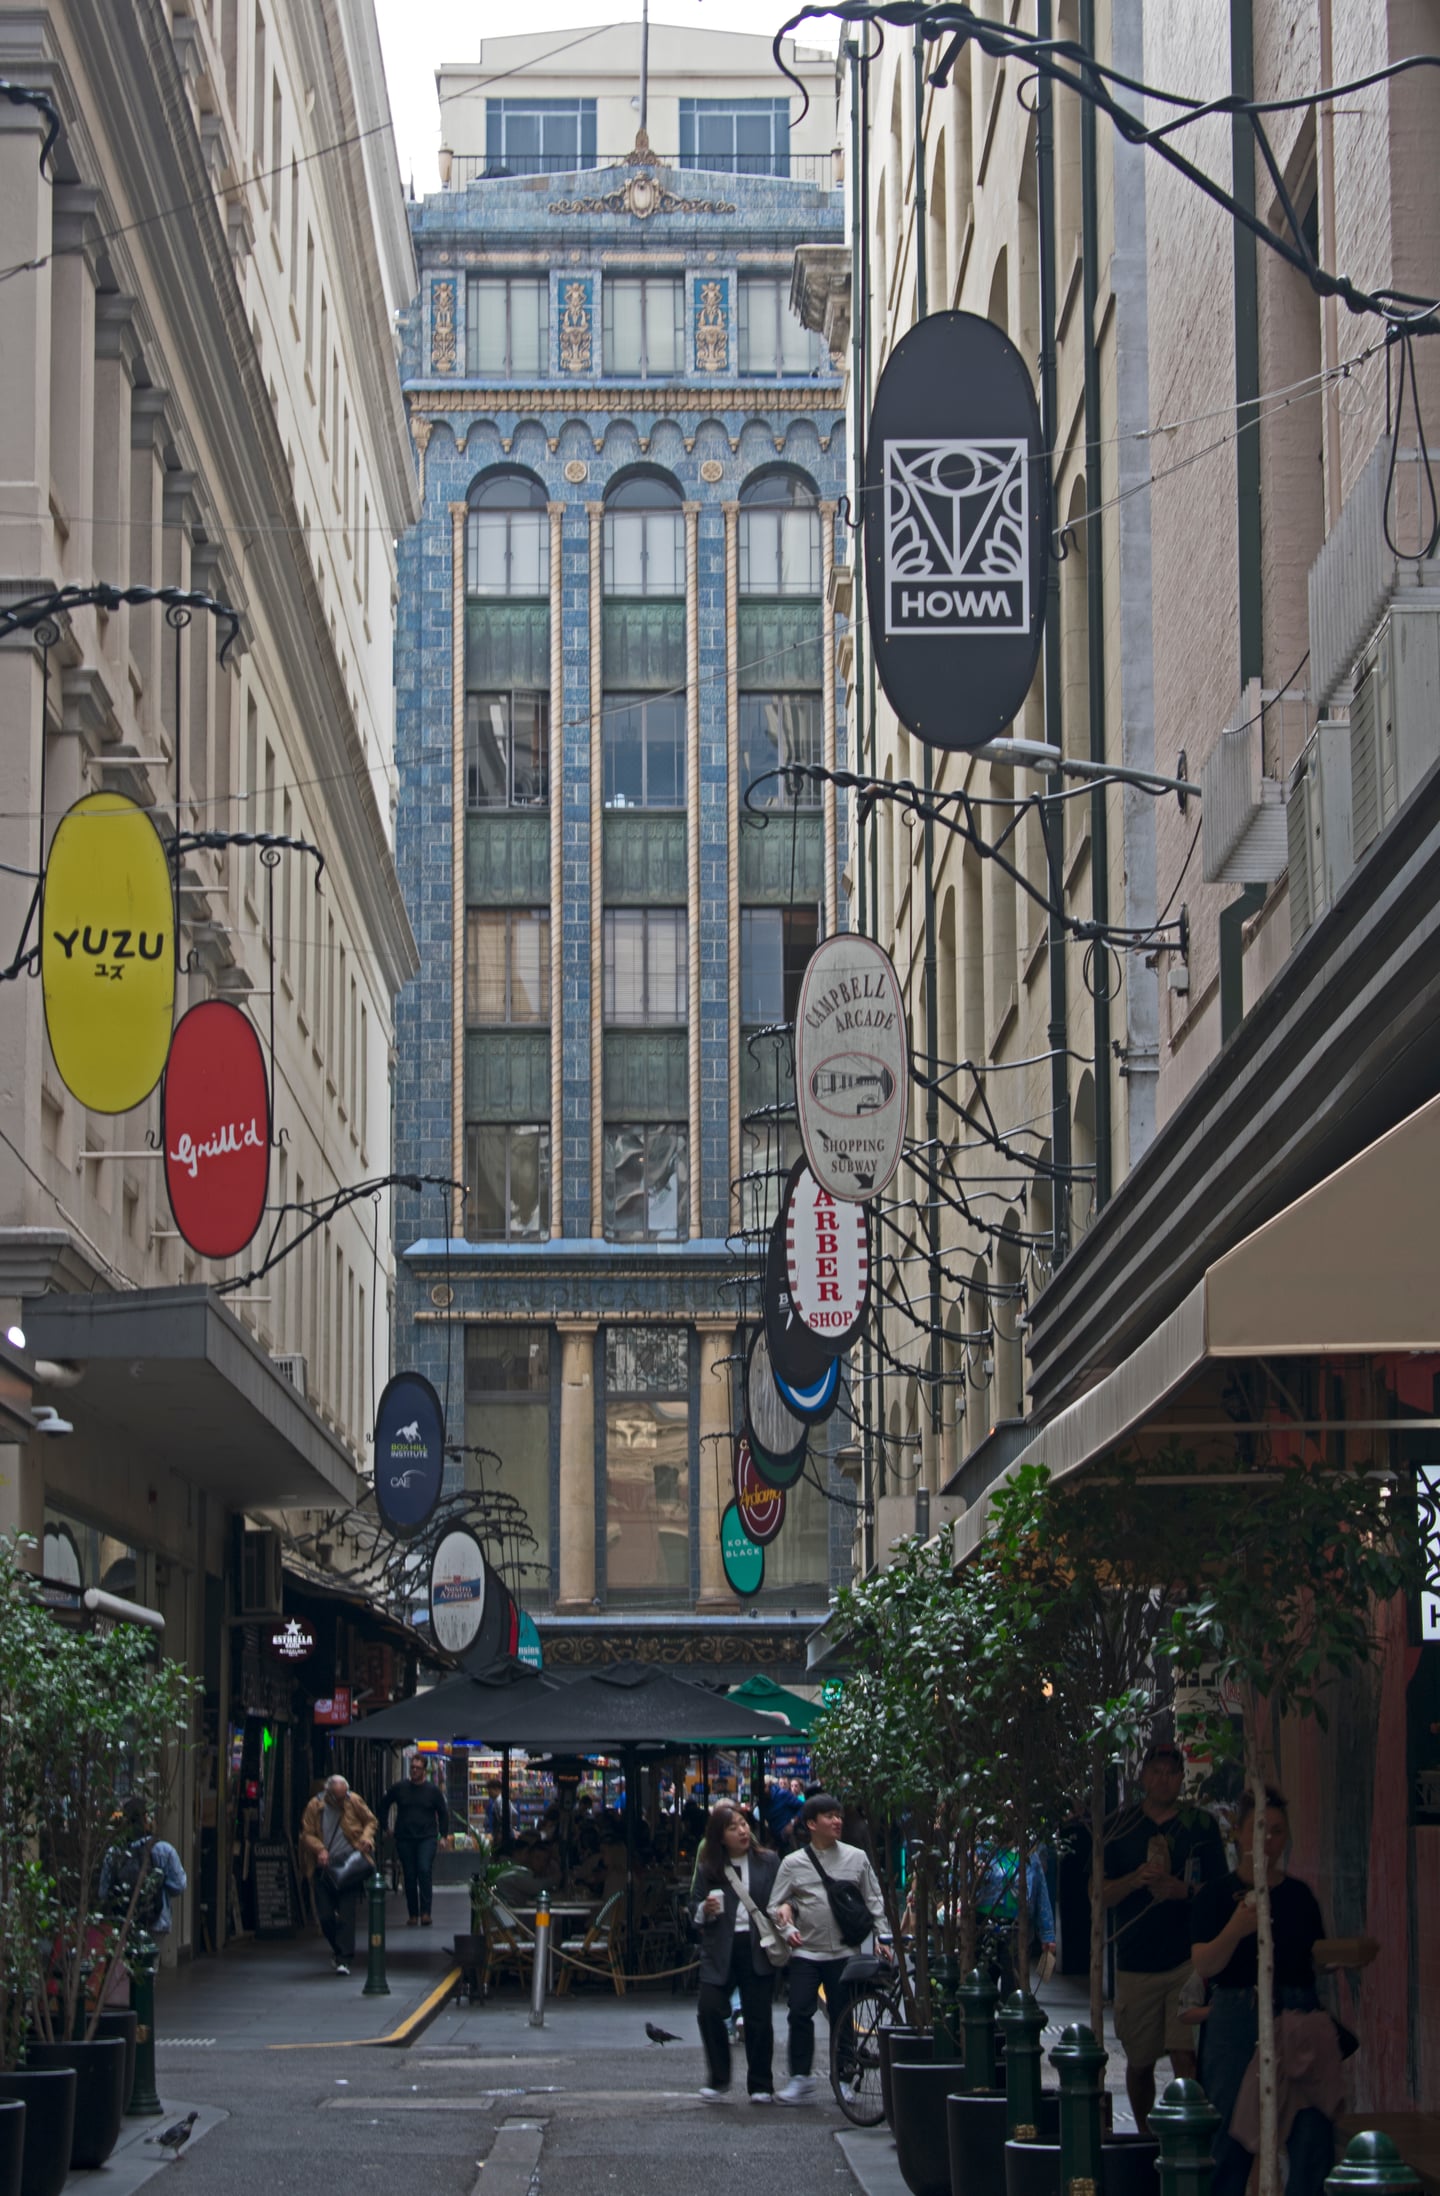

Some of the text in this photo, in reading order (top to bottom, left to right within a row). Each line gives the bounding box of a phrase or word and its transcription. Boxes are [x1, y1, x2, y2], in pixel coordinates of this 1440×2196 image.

[901, 590, 1013, 618] HOWM
[52, 926, 164, 960] YUZU
[94, 964, 126, 981] ユズ
[805, 974, 887, 1028] CAMPBELL
[835, 1008, 896, 1033] ARCADE
[171, 1119, 263, 1177] Grill'd
[823, 1139, 885, 1153] SHOPPING
[831, 1159, 878, 1174] SUBWAY
[812, 1180, 842, 1301] ARBER
[808, 1311, 854, 1329] SHOP
[390, 1450, 428, 1458] INSTITUTE
[390, 1477, 411, 1488] CAE
[728, 1537, 753, 1547] KOK
[725, 1547, 760, 1558] BLACK
[440, 1590, 473, 1599] Azzurro
[444, 1584, 472, 1593] Nastro
[272, 1635, 313, 1646] ESTRELLA
